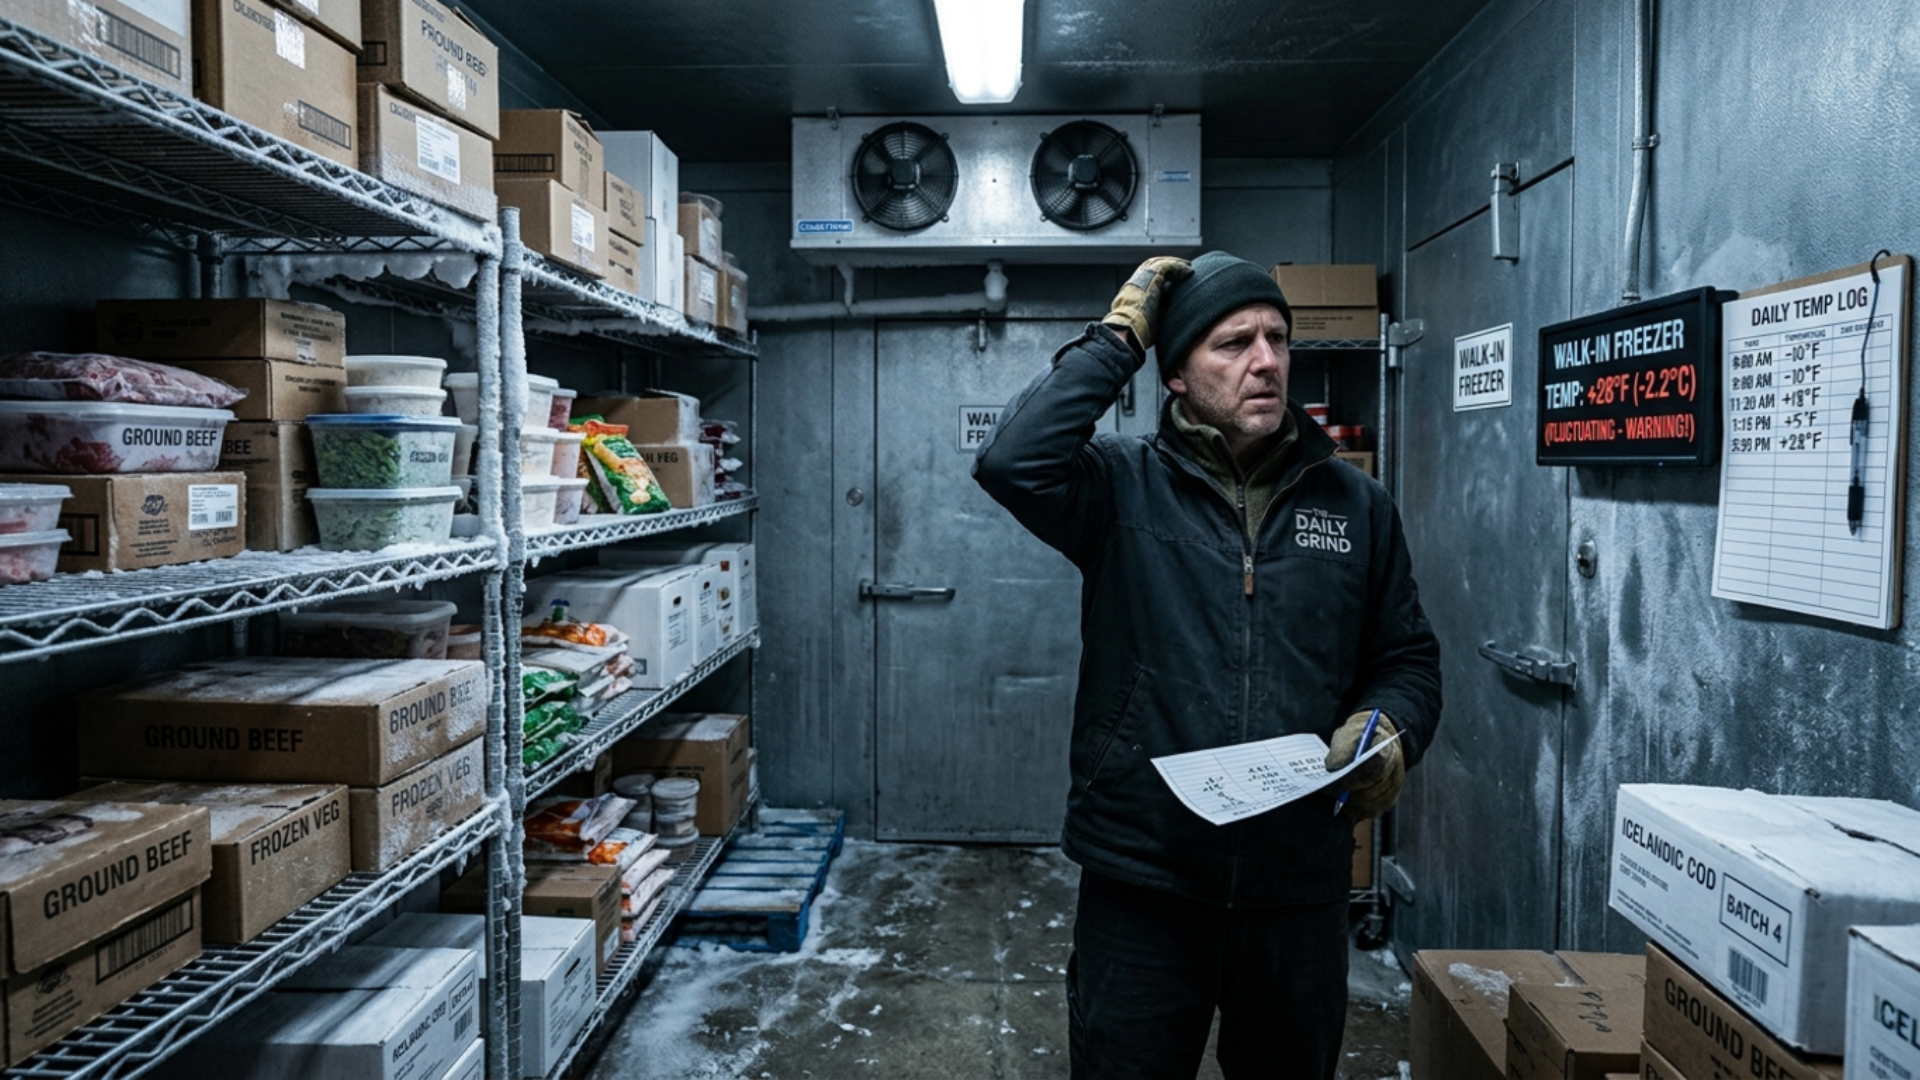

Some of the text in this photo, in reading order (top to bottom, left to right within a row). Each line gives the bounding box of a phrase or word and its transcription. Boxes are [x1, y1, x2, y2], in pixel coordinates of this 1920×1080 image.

[1751, 286, 1868, 326] DAILY TEMP LOG
[1459, 339, 1504, 369] WALK-IN
[1554, 318, 1684, 369] WALK-IN FREEZER
[1756, 351, 1773, 367] AM
[1459, 369, 1504, 397] FREEZER
[1544, 380, 1584, 409] TEMP:
[1633, 364, 1697, 407] (-2.2°C)
[1758, 393, 1775, 409] AM
[122, 427, 217, 447] GROUND BEEF
[1545, 418, 1616, 446] (FLUCTUATING
[1625, 413, 1695, 443] WARNING!)
[1755, 415, 1771, 430] PM
[1754, 436, 1771, 451] PM
[1295, 514, 1348, 536] DAILY
[1295, 532, 1352, 553] GRIND
[390, 691, 446, 734] GROUND
[144, 724, 303, 752] GROUND BEEF
[391, 770, 443, 817] FROZEN
[447, 756, 471, 784] VEG
[251, 799, 340, 866] FROZEN VEG
[1622, 817, 1684, 871] ICELANDIC
[1687, 857, 1716, 891] COD
[43, 829, 193, 919] GROUND BEEF
[1726, 894, 1769, 936] BATCH
[1772, 924, 1783, 943] 4
[1665, 977, 1743, 1060] GROUND
